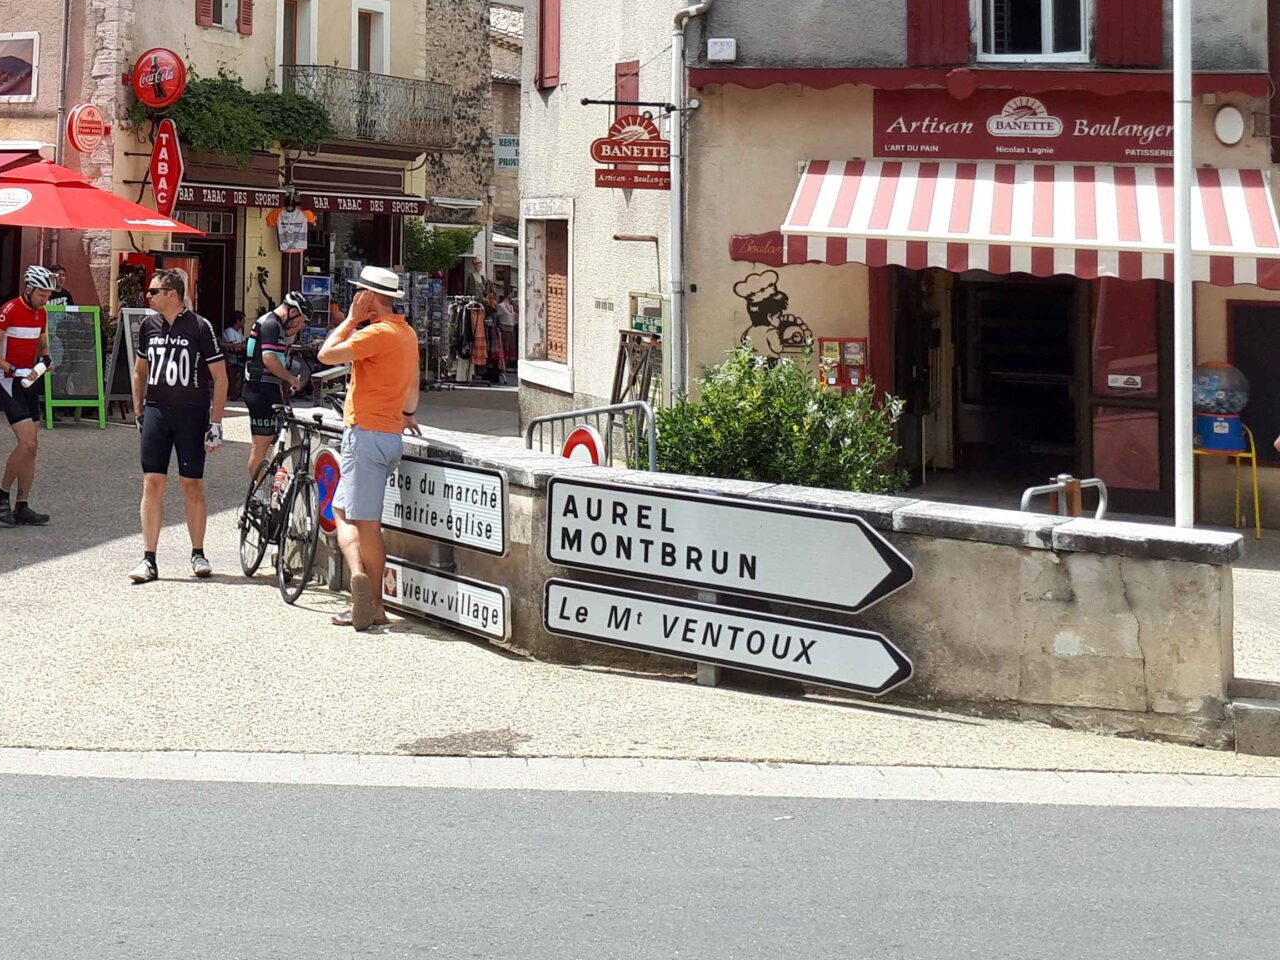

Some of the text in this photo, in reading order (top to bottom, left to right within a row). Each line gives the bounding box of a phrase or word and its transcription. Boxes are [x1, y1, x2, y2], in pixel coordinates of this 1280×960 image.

[886, 116, 1174, 145] Artisan Boulanger
[996, 121, 1055, 131] BANETTE
[601, 144, 669, 158] BANETTE
[884, 144, 905, 152] L'ART
[996, 146, 1054, 155] Nicolas Lagnie
[157, 133, 170, 204] TABAC
[179, 188, 280, 206] BAR TABAC DES SPORTS
[313, 196, 419, 214] BAR TABAC DES SPORTS
[148, 334, 189, 346] stelvio
[147, 346, 190, 387] 2760
[389, 472, 497, 509] ace du marché
[394, 501, 492, 540] mairie-église
[562, 495, 675, 533] AUREL
[561, 527, 758, 580] MONTBRUN
[558, 596, 588, 623] Le
[662, 614, 818, 665] VENTOUX
